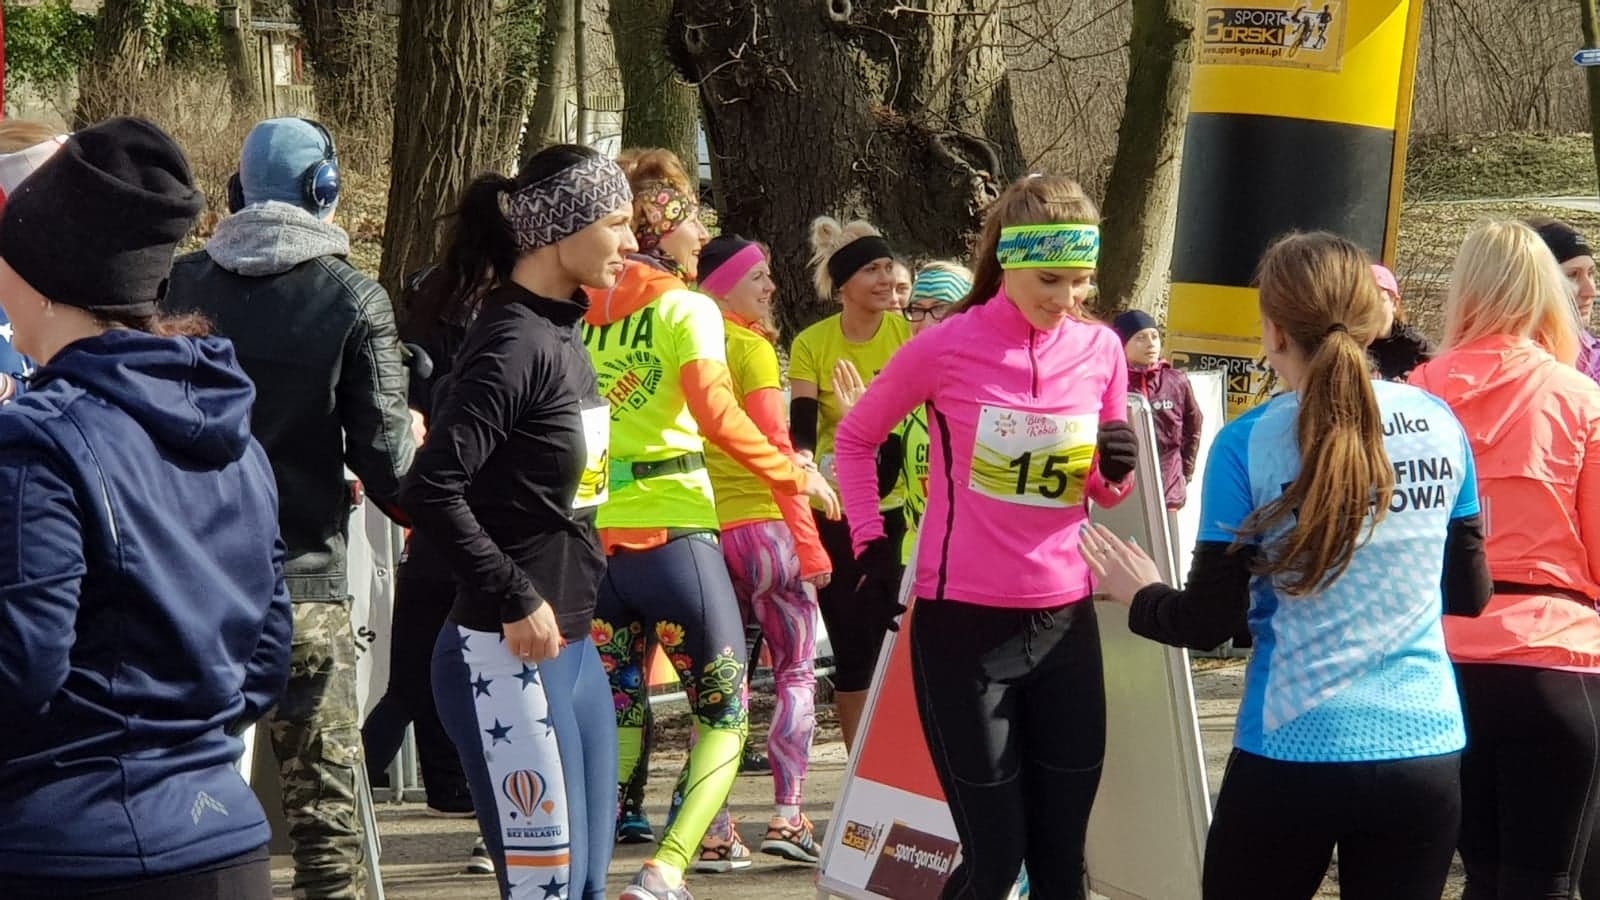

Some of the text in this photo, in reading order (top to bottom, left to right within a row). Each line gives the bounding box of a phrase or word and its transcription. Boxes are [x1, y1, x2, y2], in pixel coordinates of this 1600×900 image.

[1234, 10, 1283, 26] SPORT
[1199, 356, 1247, 373] SPORT
[606, 370, 641, 408] TEAM
[1382, 412, 1430, 437] ulka
[1009, 451, 1069, 499] 15
[1393, 456, 1454, 485] FINA
[1388, 484, 1446, 513] OWA
[524, 830, 562, 838] BALASTU
